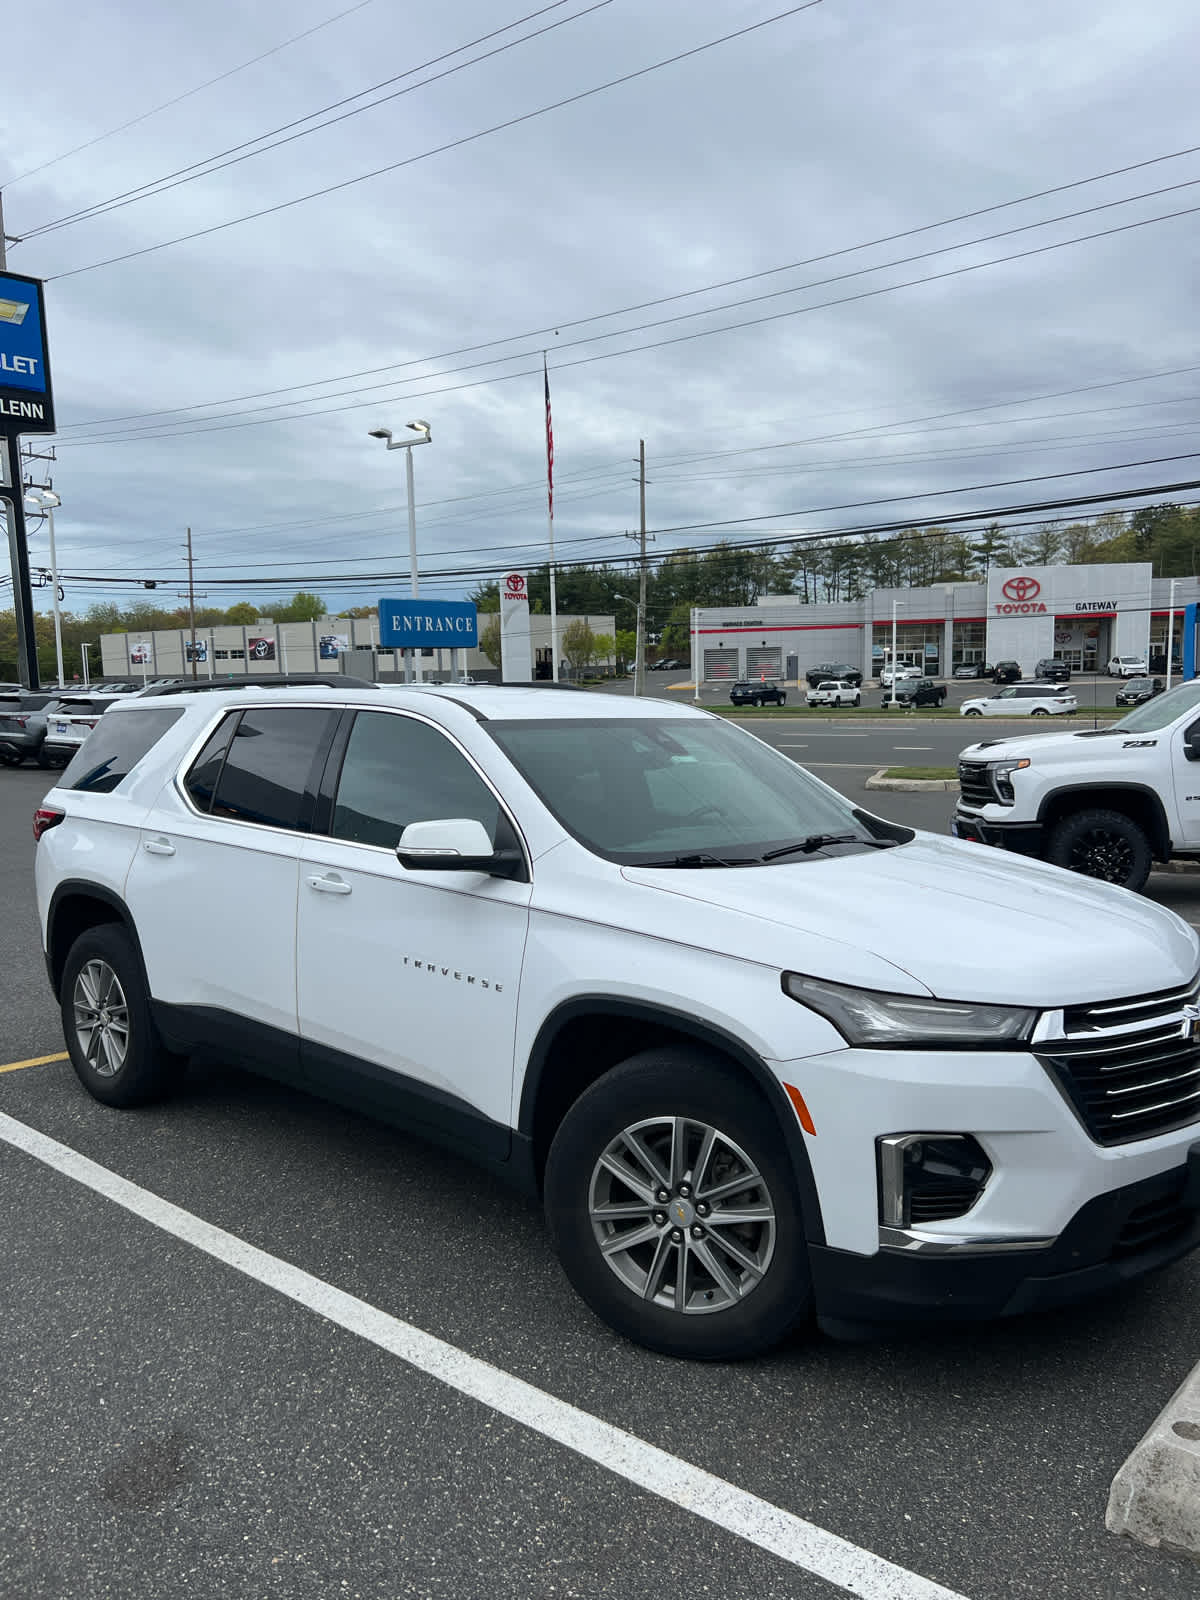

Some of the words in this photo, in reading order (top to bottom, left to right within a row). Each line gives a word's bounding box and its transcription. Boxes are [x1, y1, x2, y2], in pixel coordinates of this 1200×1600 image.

[0, 353, 38, 375] LET
[504, 592, 528, 600] TOYOTA
[995, 602, 1047, 614] TOYOTA
[1075, 601, 1118, 612] GATEWAY
[392, 615, 473, 632] ENTRANCE
[403, 957, 503, 992] TRAVERSE
